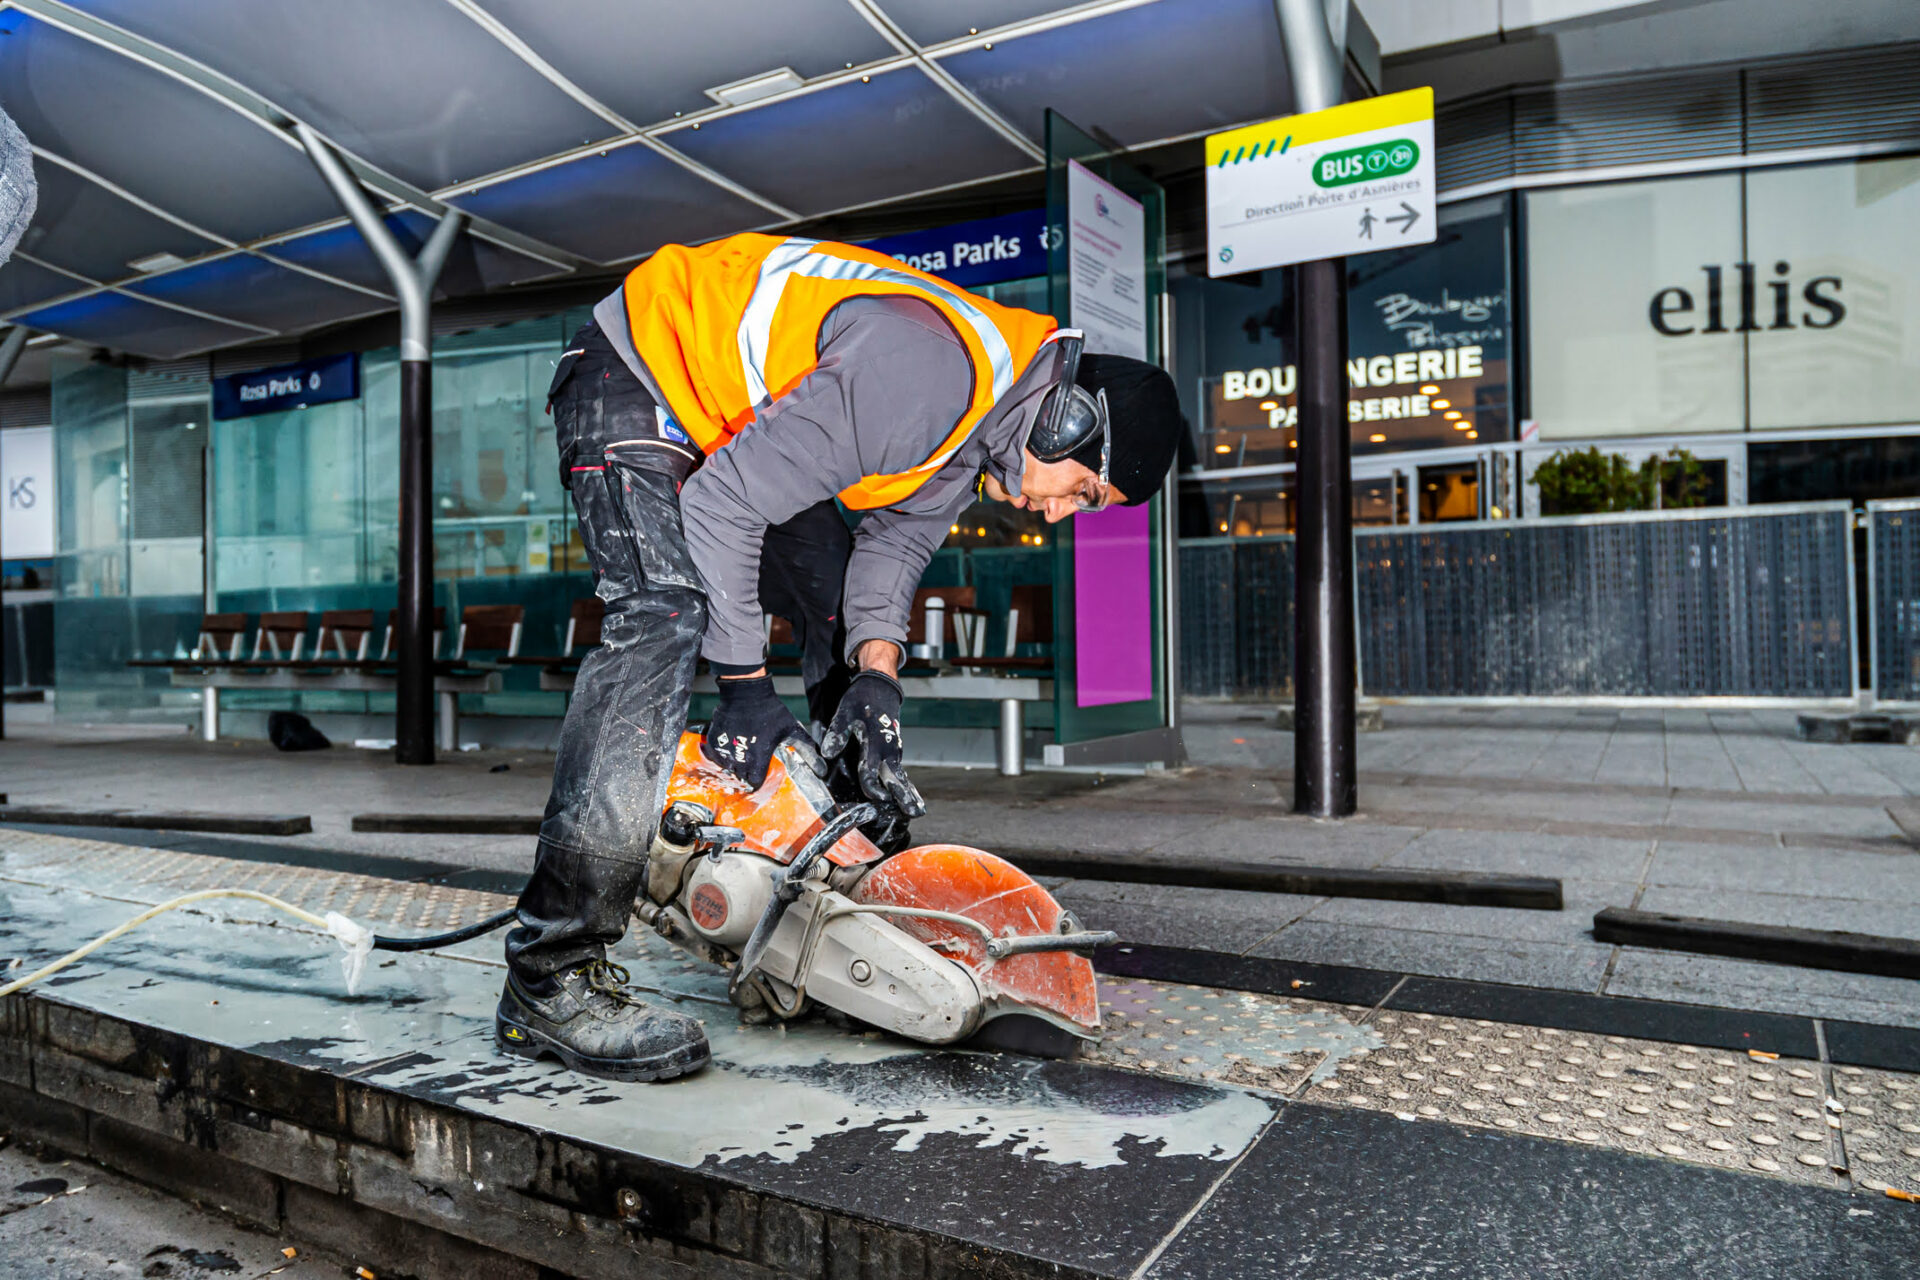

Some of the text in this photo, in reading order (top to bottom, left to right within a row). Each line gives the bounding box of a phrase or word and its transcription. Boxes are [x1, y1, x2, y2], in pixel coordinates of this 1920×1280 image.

[1322, 154, 1364, 181] BUS
[1245, 178, 1420, 219] Direction Porte d'Asnières
[953, 235, 1021, 267] Parks
[1649, 260, 1846, 337] ellis
[240, 376, 302, 402] Rosa Parks
[1223, 345, 1484, 400] BOUNGERIE
[1268, 394, 1431, 429] PASERIE
